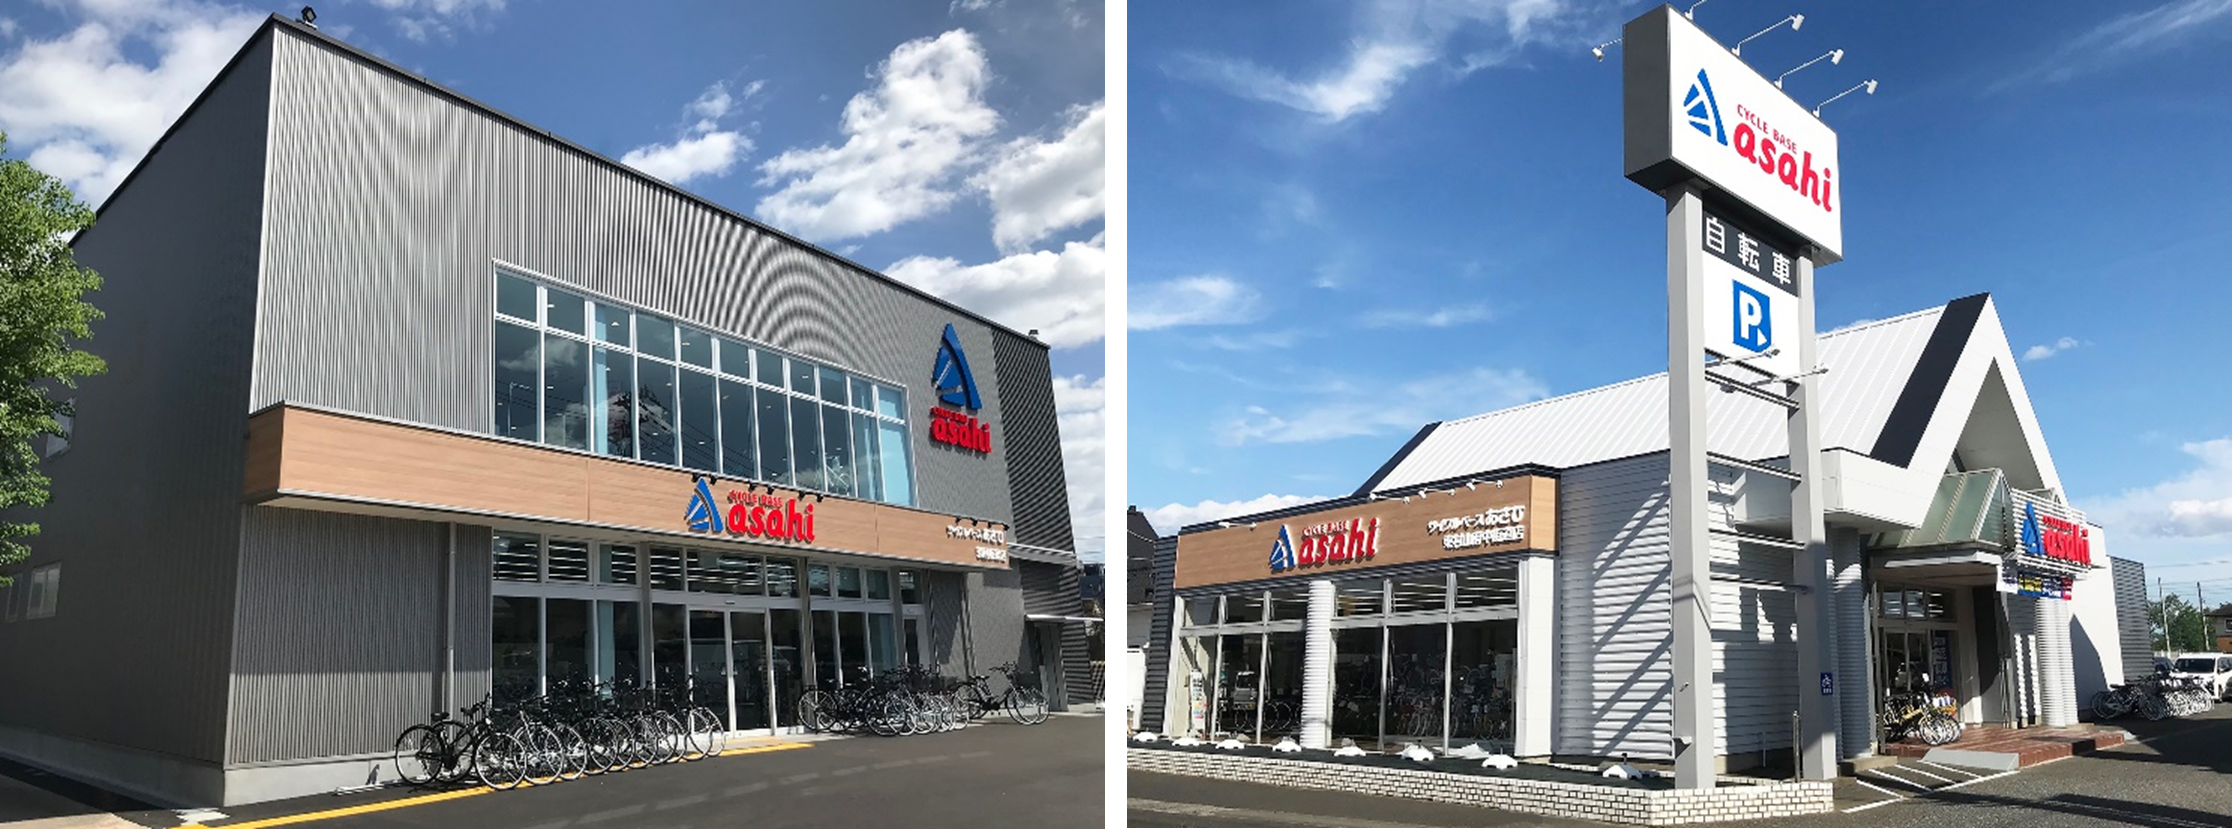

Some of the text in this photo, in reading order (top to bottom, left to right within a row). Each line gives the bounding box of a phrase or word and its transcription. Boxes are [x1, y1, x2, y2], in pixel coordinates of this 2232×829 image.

[1737, 104, 1798, 155] CYCLE BASE
[1733, 122, 1832, 213] asahi
[1706, 216, 1791, 285] 自転車
[1739, 289, 1763, 344] P
[931, 416, 993, 453] asahi
[728, 498, 815, 542] asahi
[1298, 517, 1380, 565] asahi
[2043, 523, 2092, 565] asahi
